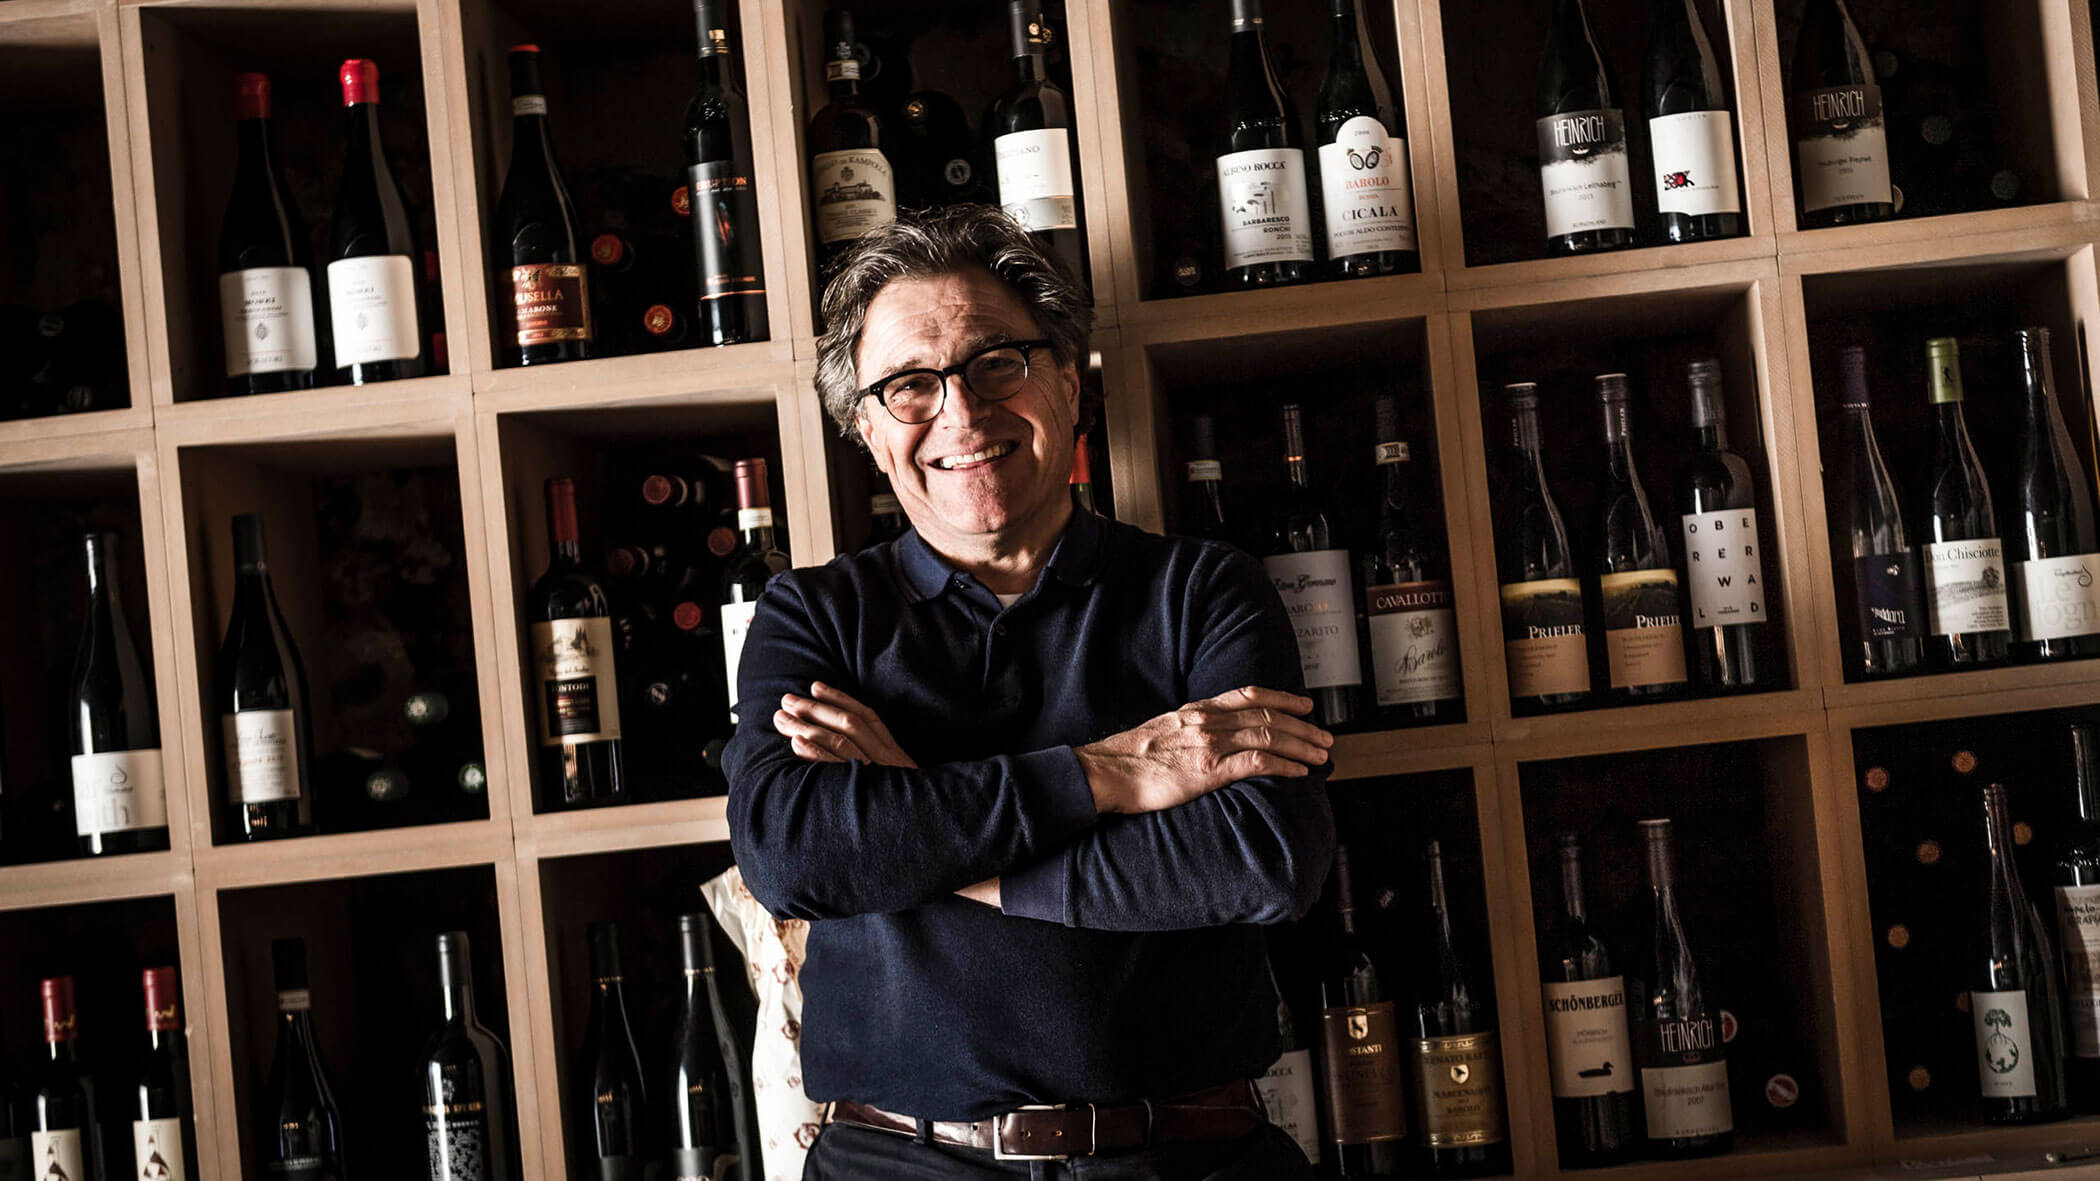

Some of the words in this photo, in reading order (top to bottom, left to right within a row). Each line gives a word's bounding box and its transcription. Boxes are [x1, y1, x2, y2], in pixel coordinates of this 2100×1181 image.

[1812, 88, 1865, 121] HEINRICH
[1553, 115, 1606, 147] HEINRICH
[1254, 160, 1287, 172] ROCCA
[1345, 175, 1390, 191] BAROLO
[1243, 215, 1291, 226] BARBARESCO
[1342, 206, 1399, 222] CICALA
[1355, 226, 1376, 235] ALDO
[1946, 544, 2000, 561] Chisciotte
[1295, 624, 1339, 638] ZARITO
[1528, 623, 1583, 640] PRIELER
[554, 681, 590, 693] ONTODI
[1659, 1018, 1715, 1053] HEINRICH
[1347, 1043, 1383, 1056] STANTI
[1264, 1067, 1293, 1078] OCCA
